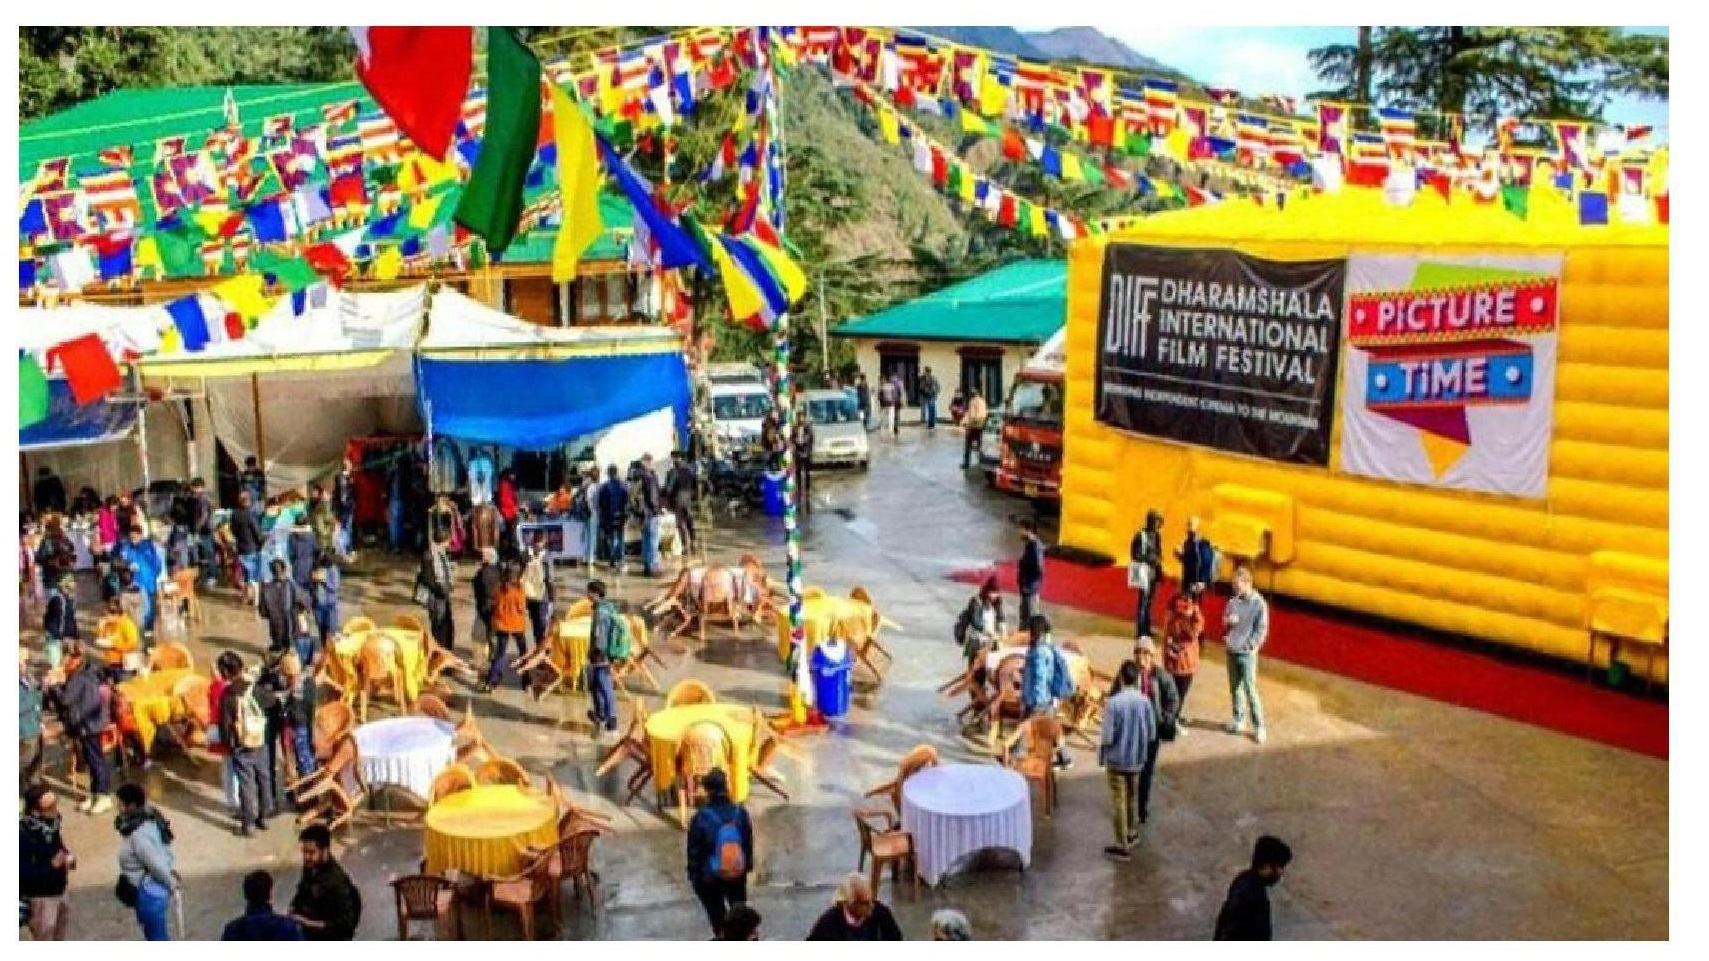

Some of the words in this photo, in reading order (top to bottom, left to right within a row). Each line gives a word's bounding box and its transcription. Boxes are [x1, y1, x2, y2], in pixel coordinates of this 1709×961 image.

[1105, 273, 1159, 357] DIFF
[1161, 279, 1334, 319] DHARAMSHALA
[1159, 308, 1328, 352] INTERNATIONAL
[1158, 337, 1208, 367] FILM
[1215, 344, 1315, 384] FESTIVAL
